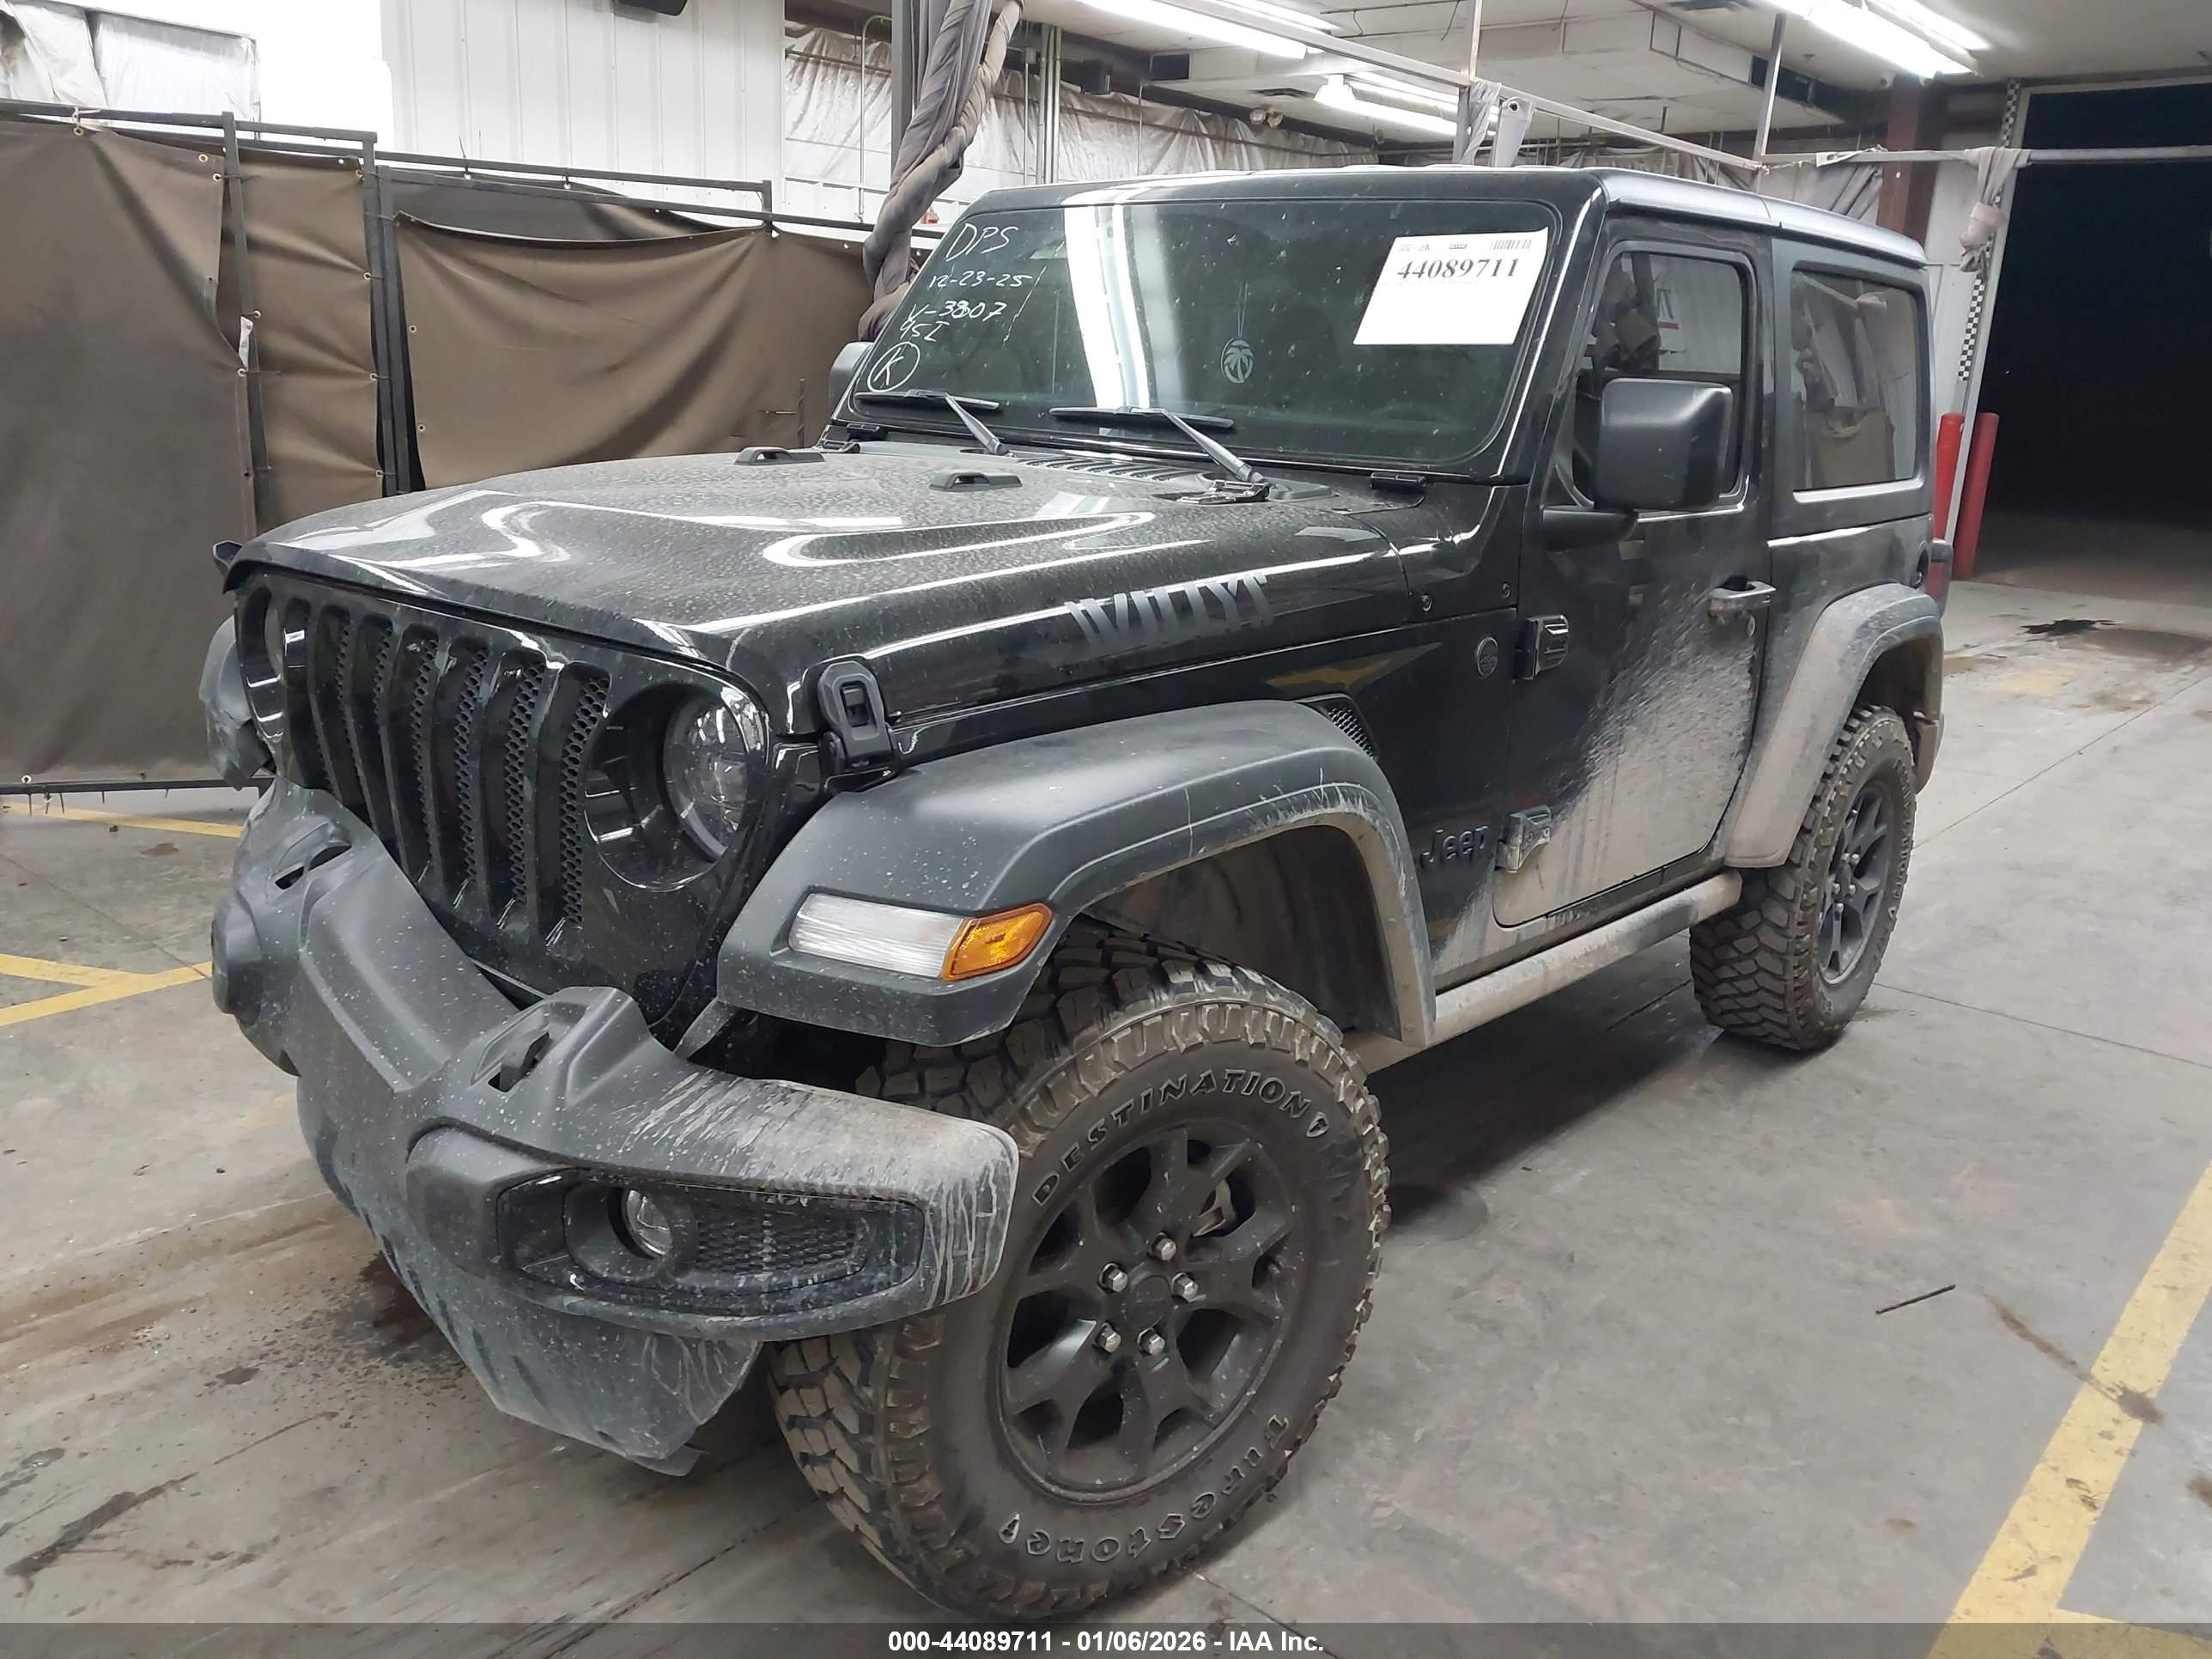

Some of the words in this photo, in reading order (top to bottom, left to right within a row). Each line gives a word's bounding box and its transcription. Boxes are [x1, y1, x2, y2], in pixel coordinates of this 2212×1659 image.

[945, 222, 1019, 262] DPS
[928, 270, 1034, 289] 12-23-25
[1396, 258, 1519, 279] 44089711
[1420, 825, 1490, 868] Jeep
[1031, 1067, 1312, 1206] DESTINATION
